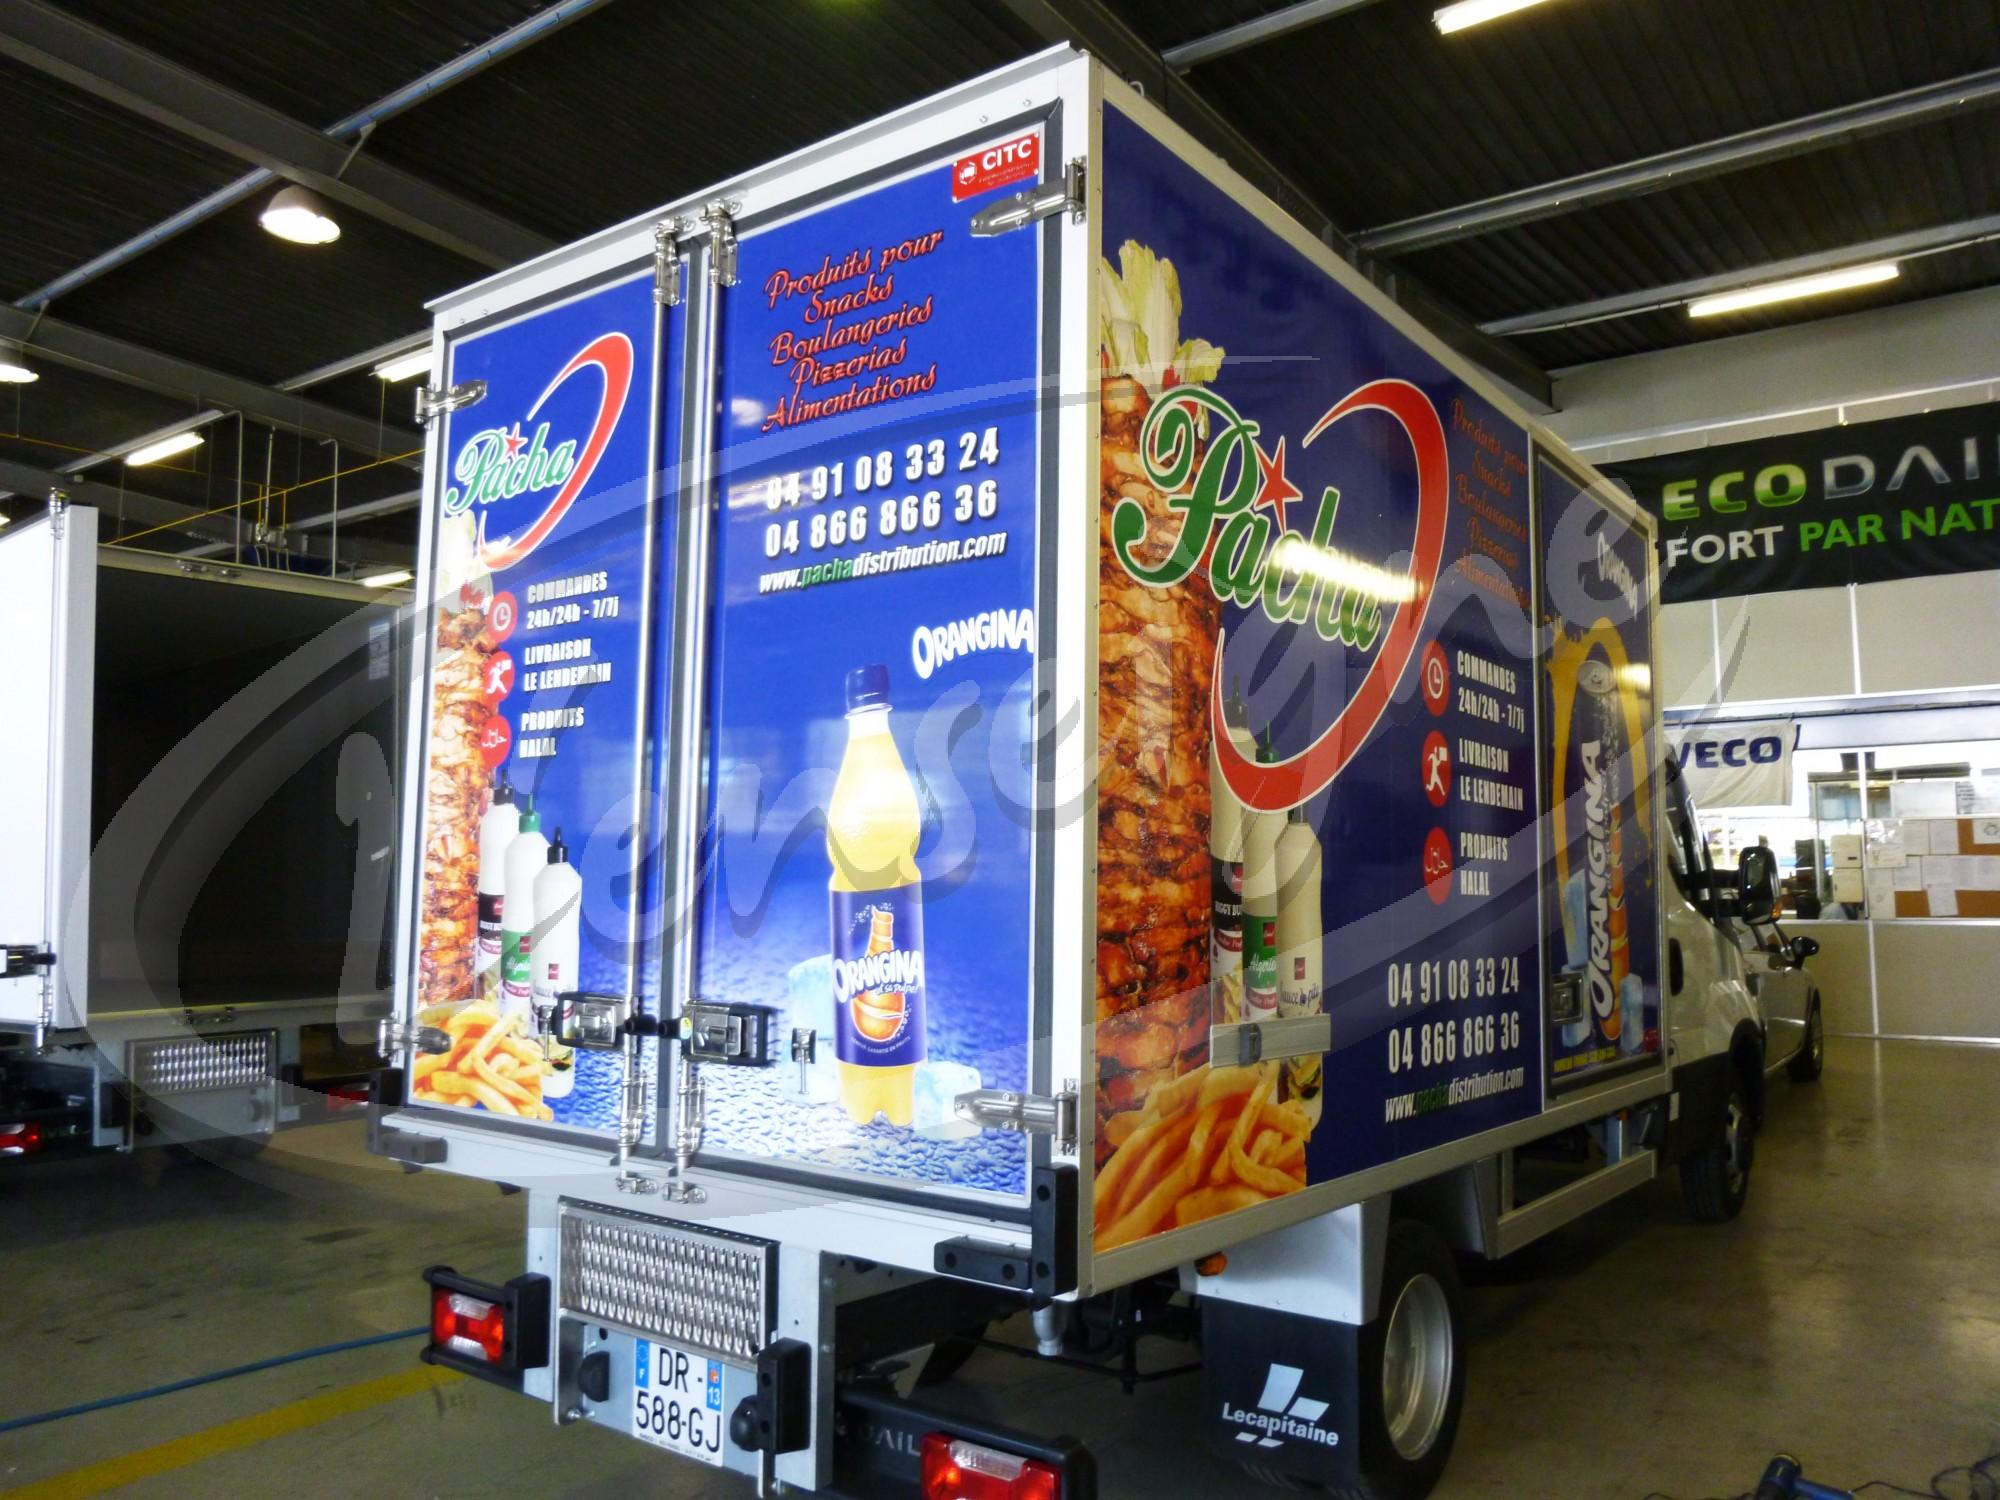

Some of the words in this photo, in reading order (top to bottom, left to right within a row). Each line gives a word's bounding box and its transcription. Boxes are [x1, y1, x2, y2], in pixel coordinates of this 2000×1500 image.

[982, 138, 1032, 171] CITC
[763, 249, 872, 310] Produits
[880, 230, 945, 273] pour
[803, 273, 894, 325] Snacks
[769, 295, 933, 366] Boulangeries
[789, 337, 908, 395] Pizzerias
[761, 362, 938, 432] Alimentations
[446, 422, 577, 515] Pacha
[766, 471, 801, 511] 04
[811, 462, 845, 501] 91
[854, 450, 893, 492] 08
[905, 439, 945, 481] 33
[959, 427, 999, 472] 24
[1662, 434, 2000, 521] ECODAI
[765, 520, 800, 558] 04
[810, 505, 868, 550] 866
[879, 490, 941, 536] 866
[954, 479, 998, 522] 36
[1666, 525, 1784, 568] FORT
[1799, 513, 1887, 552] PAR
[527, 571, 608, 604] COMMANDES
[759, 532, 1008, 594] www.pachadistribution.com
[524, 638, 592, 666] LIVRAISON
[912, 608, 1035, 679] ORANGINA
[524, 672, 538, 692] LE
[540, 663, 612, 690] LENDEMAIN
[1457, 650, 1516, 696] COMMANDES
[521, 707, 585, 732] PRODUITS
[519, 737, 557, 759] HALAL
[1459, 738, 1509, 774] LIVRAISON
[1460, 775, 1472, 802] LE
[1473, 777, 1524, 812] LENDEMAIN
[1460, 832, 1509, 862] PRODUITS
[1460, 870, 1490, 896] HALAL
[1581, 739, 1614, 1019] ORANGINA
[833, 949, 925, 1004] ORANGINA
[1387, 962, 1413, 1008] 04
[1420, 960, 1441, 1004] 91
[1447, 958, 1469, 1001] 08
[1475, 957, 1496, 998] 33
[1501, 956, 1520, 995] 24
[1388, 1026, 1413, 1074] 04
[1421, 1020, 1456, 1067] 866
[1463, 1013, 1495, 1059] 866
[1500, 1010, 1520, 1050] 36
[638, 1367, 646, 1380] F
[708, 1386, 721, 1406] 13
[635, 1389, 721, 1453] 588-GJ
[1221, 1401, 1340, 1447] Lecapitaine
